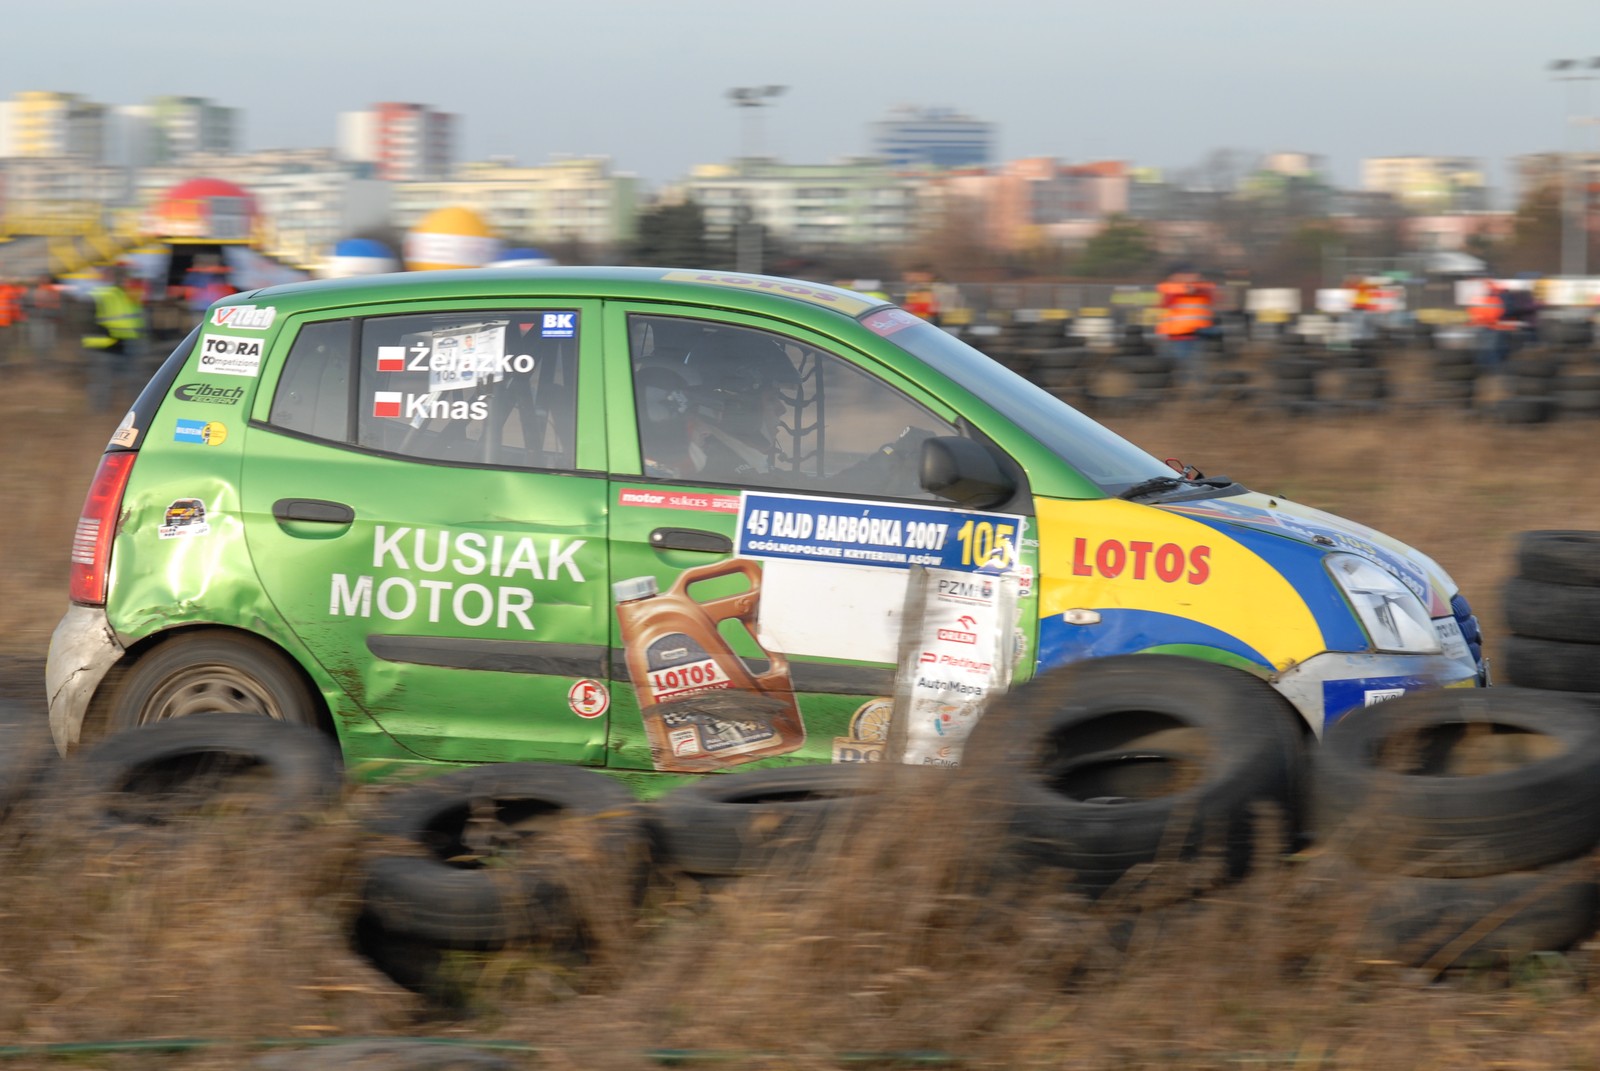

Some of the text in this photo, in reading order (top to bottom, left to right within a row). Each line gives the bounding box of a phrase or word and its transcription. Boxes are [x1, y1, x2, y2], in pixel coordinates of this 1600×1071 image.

[696, 275, 840, 302] LOTOS
[543, 314, 574, 328] BK
[206, 339, 259, 356] TOORA
[407, 342, 535, 373] Żelazko
[174, 384, 244, 400] Eibach
[406, 393, 488, 420] Knaś
[622, 493, 665, 503] motor
[746, 509, 1015, 569] 45 RAJD BARBÓRKA 2007 105
[373, 525, 587, 583] KUSIAK
[748, 540, 842, 557] OGÓLNOPOLSKIE
[908, 553, 943, 566] ASÓW
[1073, 537, 1211, 585] LOTOS
[329, 573, 536, 631] MOTOR
[654, 662, 716, 692] LOTOS
